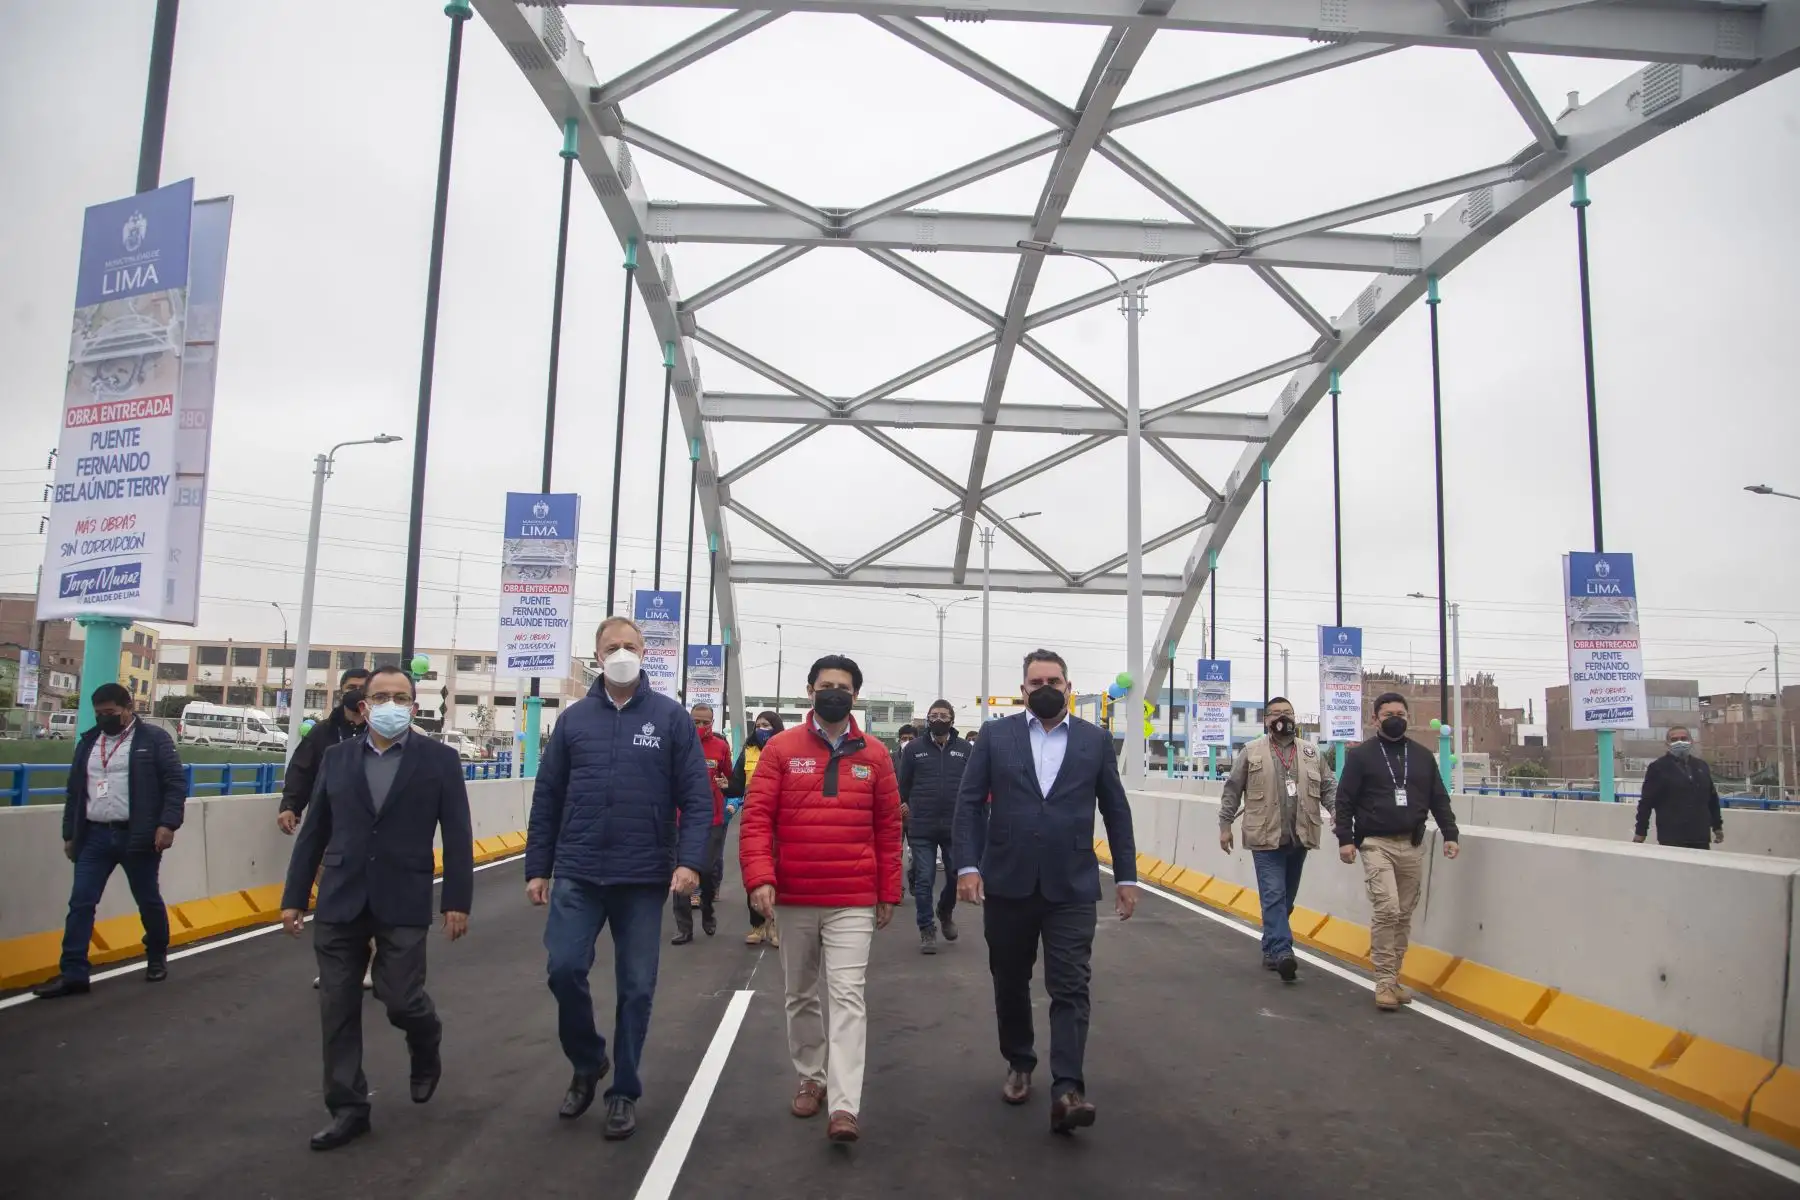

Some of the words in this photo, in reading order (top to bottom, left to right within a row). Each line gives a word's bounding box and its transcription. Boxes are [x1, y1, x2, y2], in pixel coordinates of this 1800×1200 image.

[102, 263, 159, 295] LIMA
[67, 406, 98, 426] OBRA
[100, 397, 171, 422] ENTREGADA
[90, 427, 141, 451] PUENTE
[76, 451, 150, 477] FERNANDO
[55, 476, 125, 503] BELAÚNDE
[127, 474, 170, 498] TERRY
[75, 516, 97, 535] MÁS
[101, 514, 136, 532] OBRAS
[521, 525, 558, 536] LIMA
[61, 539, 77, 557] SIN
[81, 532, 146, 556] CORRUPCIÓN
[62, 573, 96, 599] Jorge
[95, 567, 140, 592] Muñoz
[1586, 583, 1622, 594] LIMA
[504, 585, 524, 593] OBRA
[525, 585, 568, 593] ENTREGADA
[83, 594, 112, 604] ALCALDE
[113, 593, 121, 601] DE
[123, 590, 140, 600] LIMA
[520, 596, 551, 605] PUENTE
[512, 606, 557, 616] FERNANDO
[645, 611, 669, 619] LIMA
[500, 616, 542, 627] BELAÚNDE
[543, 618, 569, 627] TERRY
[1332, 647, 1353, 655] LIMA
[1591, 651, 1622, 660] PUENTE
[1585, 662, 1630, 670] FERNANDO
[1573, 671, 1617, 681] BELAÚNDE
[1618, 672, 1642, 681] TERRY
[633, 737, 660, 749] LIMA
